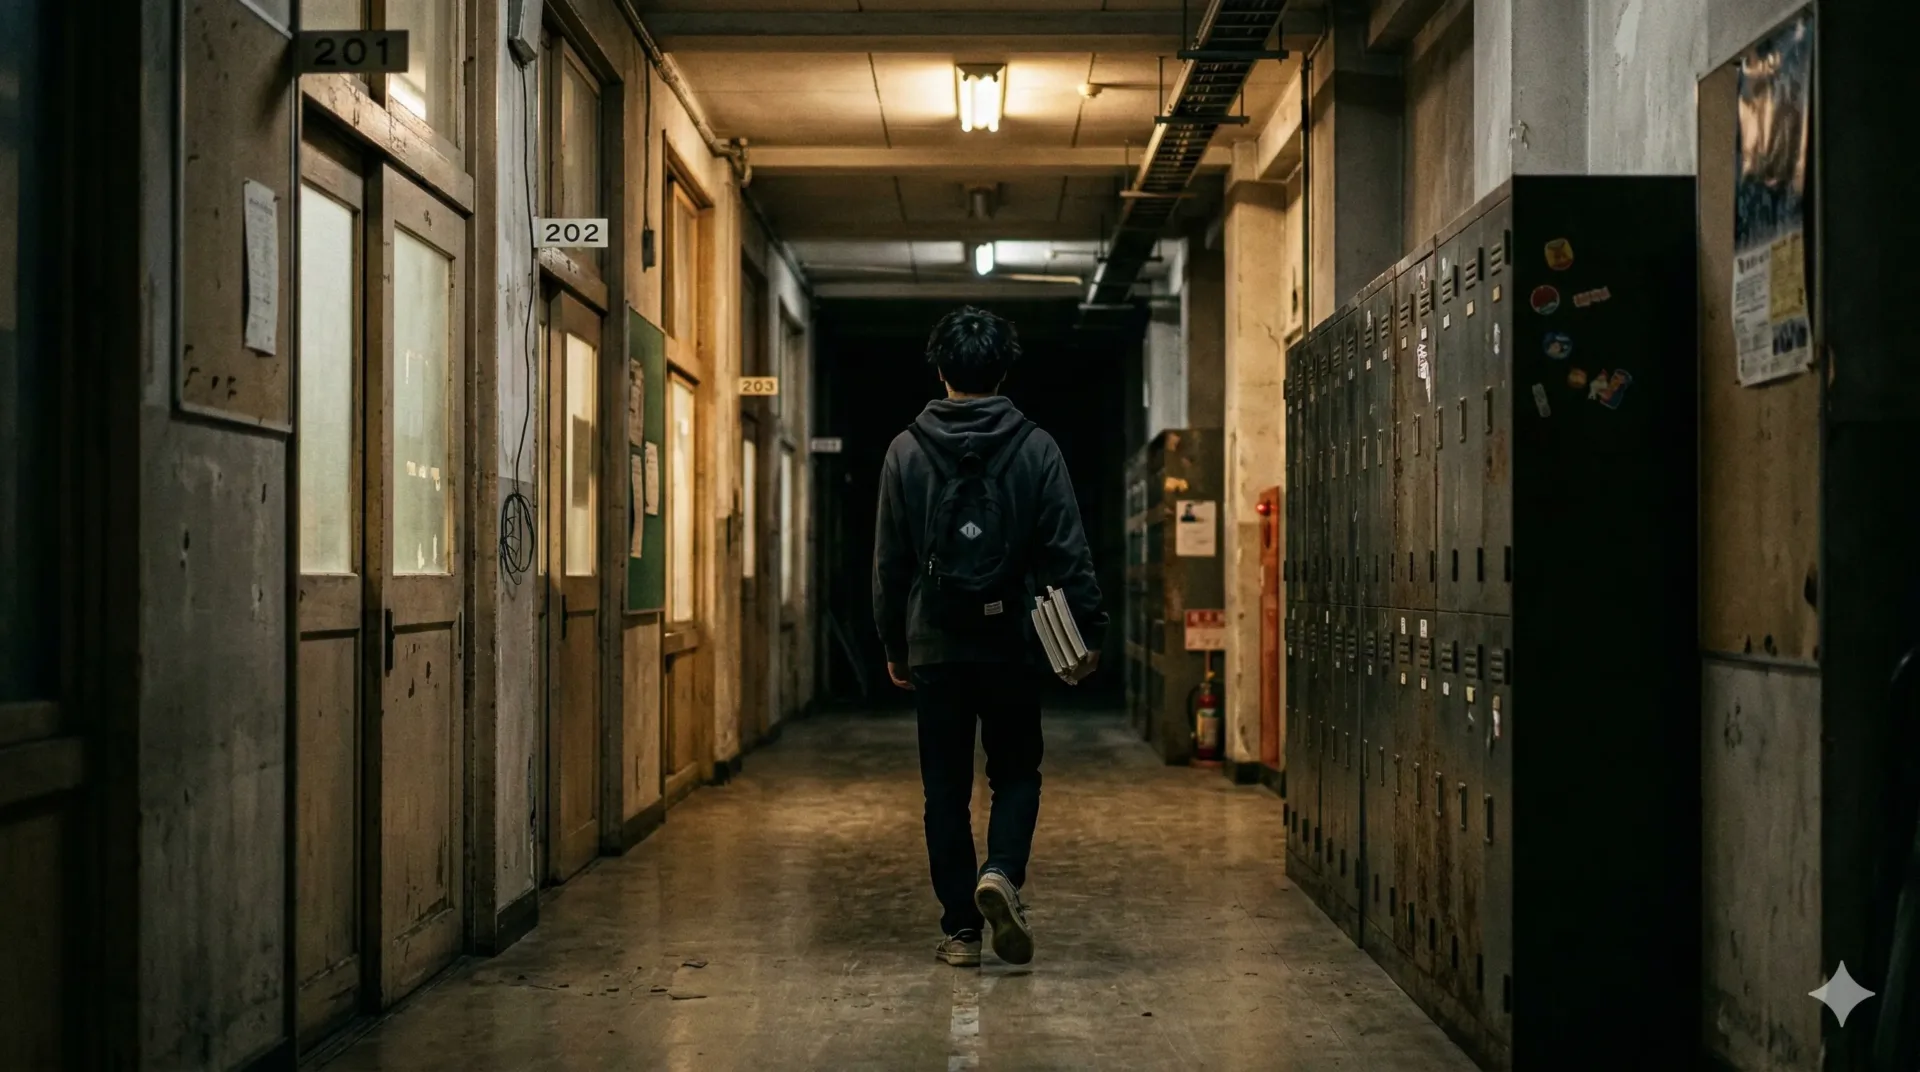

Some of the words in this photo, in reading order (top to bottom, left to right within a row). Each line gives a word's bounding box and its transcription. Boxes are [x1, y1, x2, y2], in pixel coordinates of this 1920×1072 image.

[314, 38, 388, 66] 201
[546, 224, 598, 242] 202
[743, 380, 774, 392] 203
